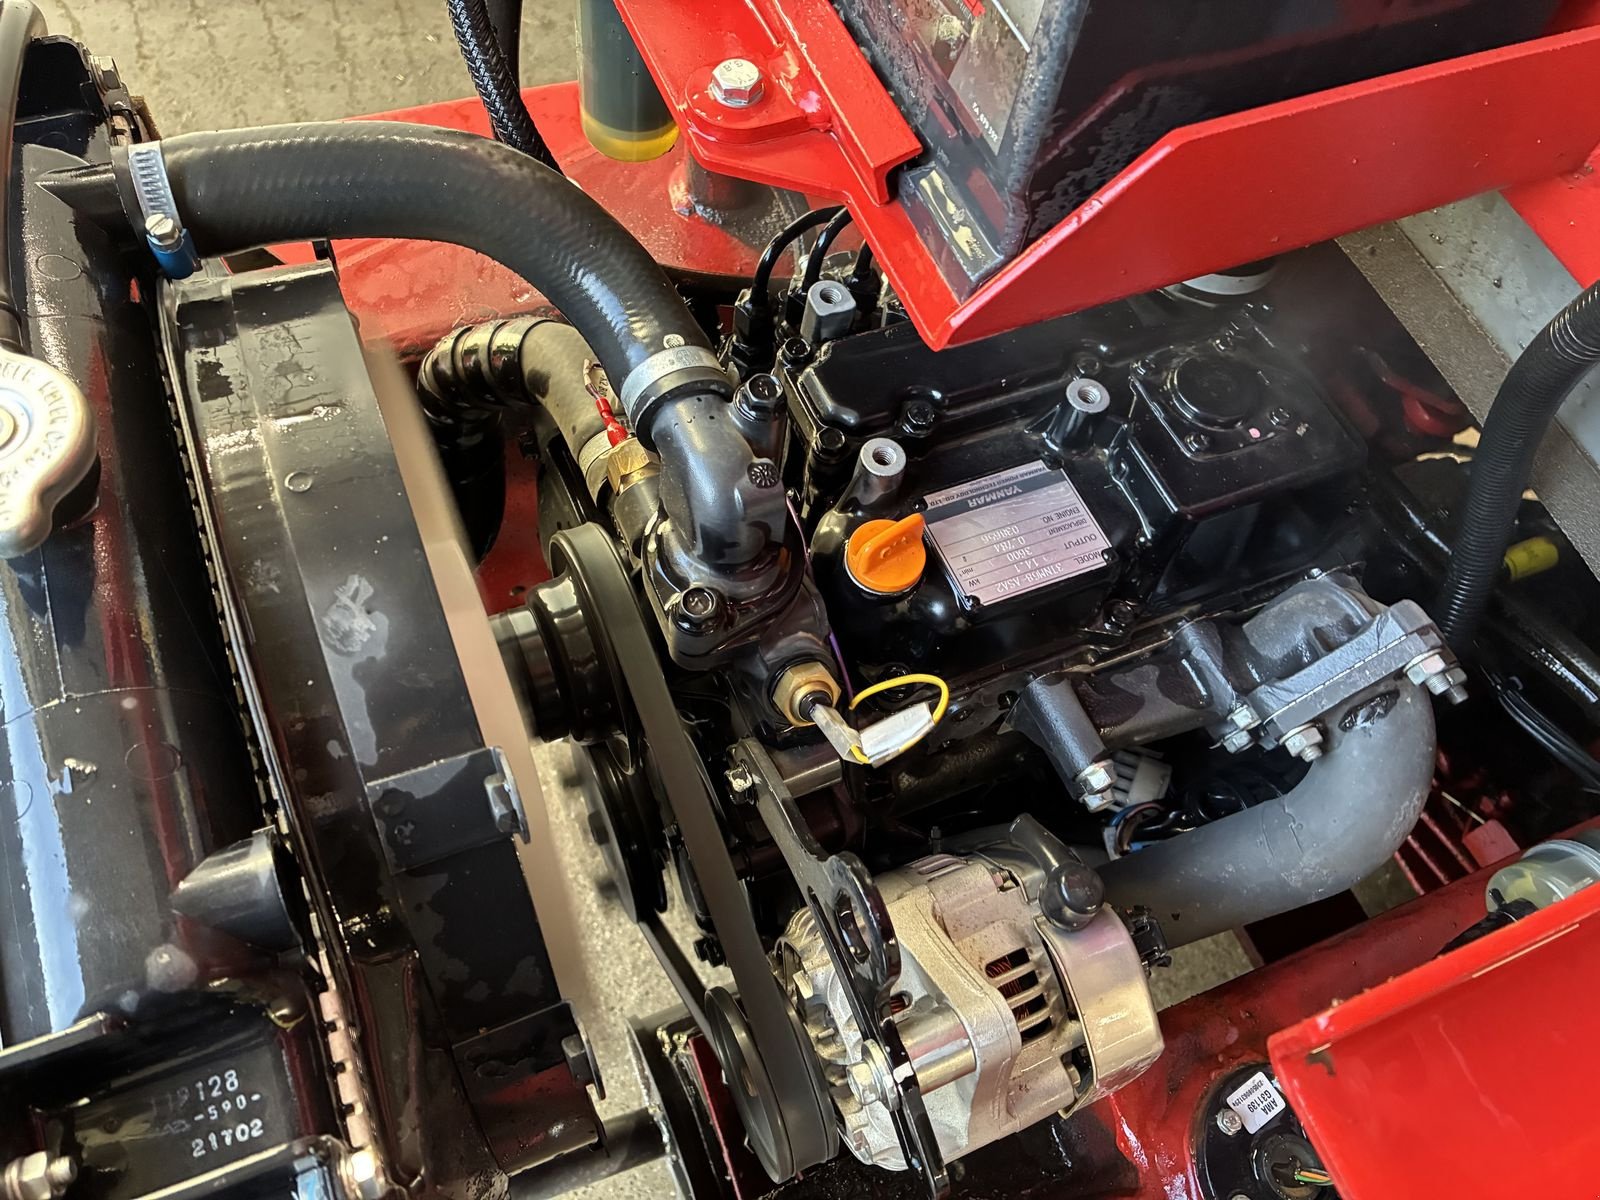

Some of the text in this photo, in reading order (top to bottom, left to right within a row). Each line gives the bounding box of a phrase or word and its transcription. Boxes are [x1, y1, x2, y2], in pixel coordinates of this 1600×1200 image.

[967, 484, 1022, 508] YANMAR
[1040, 514, 1053, 524] NO.
[1054, 506, 1080, 520] ENGINE
[1048, 518, 1087, 535] DISPLACEMENT
[1063, 533, 1097, 550] OUTPUT
[1006, 547, 1033, 562] 3600
[1074, 551, 1101, 565] MODEL
[968, 578, 980, 587] kW
[1247, 1089, 1272, 1113] G31139
[1261, 1098, 1279, 1115] AMA
[192, 1118, 264, 1158] 21702
